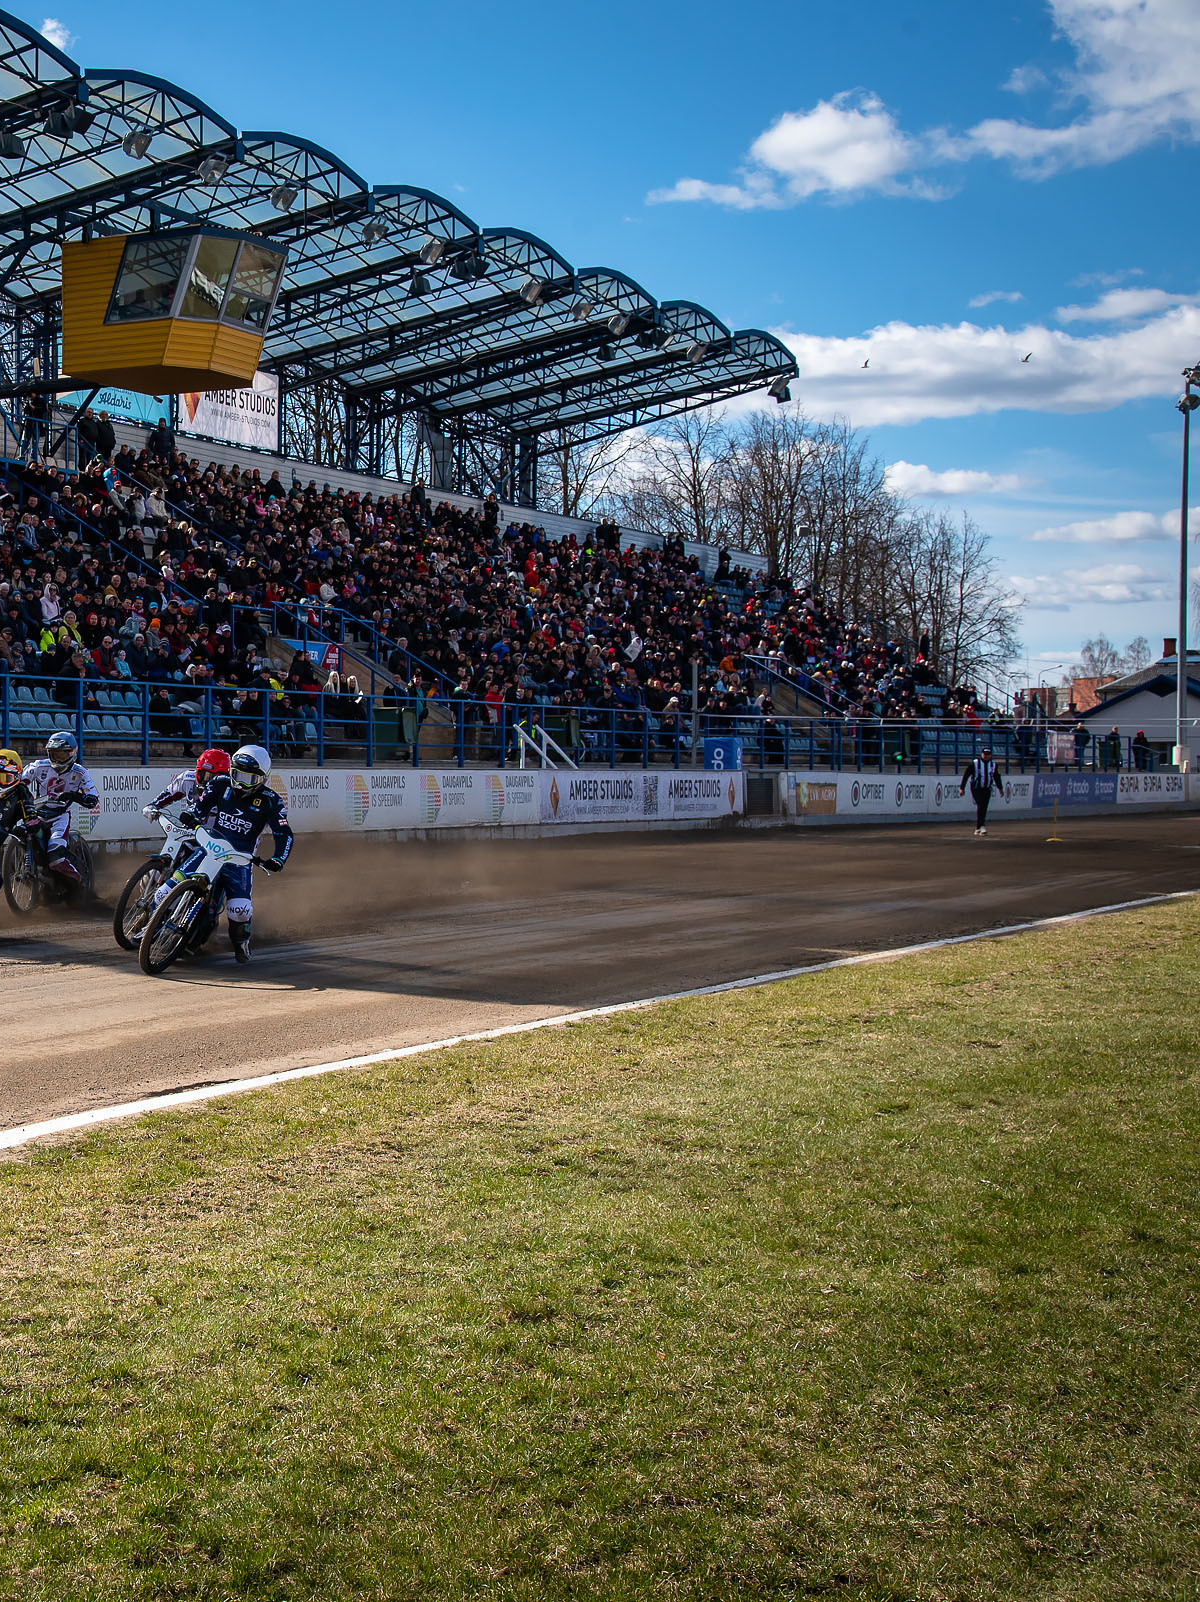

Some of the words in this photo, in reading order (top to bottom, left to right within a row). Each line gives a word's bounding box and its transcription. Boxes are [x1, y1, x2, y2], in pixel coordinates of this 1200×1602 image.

[98, 392, 132, 410] Aldaris
[204, 390, 236, 409] AMBER
[238, 391, 276, 417] STUDIOS
[103, 776, 150, 791] DAUGAVPILS
[290, 776, 329, 790] DAUGAVPILS
[371, 776, 406, 789] DAUGAVPILS
[442, 775, 472, 789] DAUGAVPILS
[505, 776, 534, 788] DAUGAVPILS
[569, 779, 598, 800] AMBER
[600, 779, 634, 800] STUDIOS
[668, 780, 693, 798] AMBER
[694, 779, 720, 798] STUDIOS
[862, 783, 885, 800] OPTIBET
[904, 784, 925, 800] OPTIBET
[944, 784, 961, 799] OPTIBE
[1012, 783, 1030, 797] OPTIBET
[103, 797, 110, 813] IR
[112, 796, 138, 812] SPORTS
[290, 795, 297, 809] IR
[298, 794, 319, 808] SPORTS
[378, 792, 403, 807] SPEEDWAY
[450, 792, 465, 805] SPORTS
